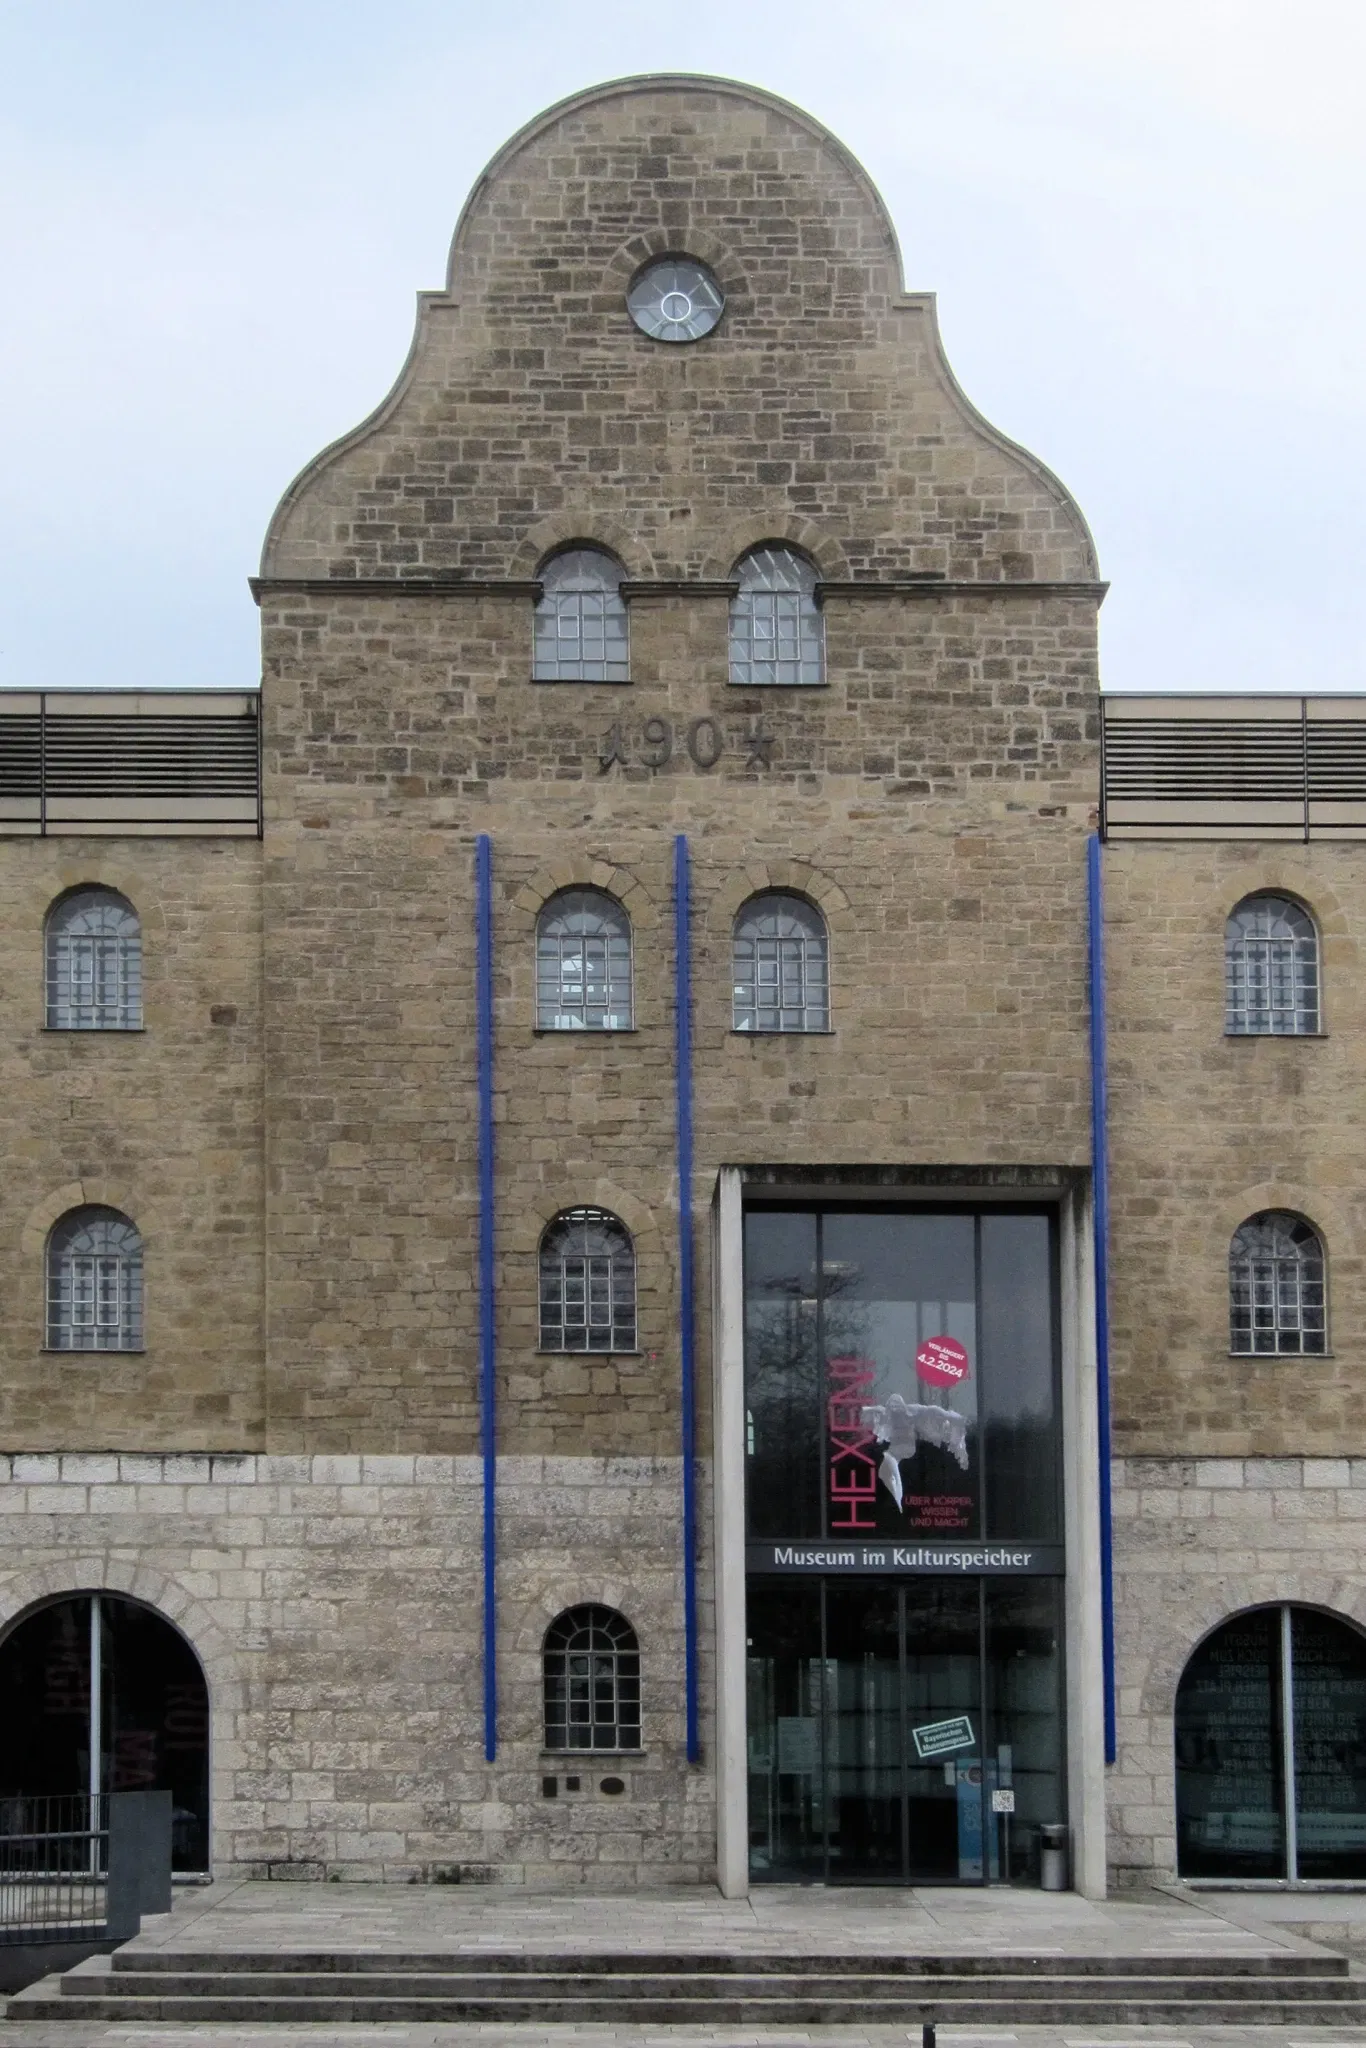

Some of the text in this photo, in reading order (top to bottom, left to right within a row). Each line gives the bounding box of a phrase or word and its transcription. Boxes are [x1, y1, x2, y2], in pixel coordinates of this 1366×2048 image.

[928, 1341, 965, 1360] VERLÄNGERT
[939, 1352, 949, 1361] BIS
[917, 1353, 963, 1378] 4.2.2024
[921, 1506, 958, 1516] WISSEN
[910, 1517, 969, 1527] UND MACHT
[774, 1547, 1032, 1571] Museum im Kulturspeicher
